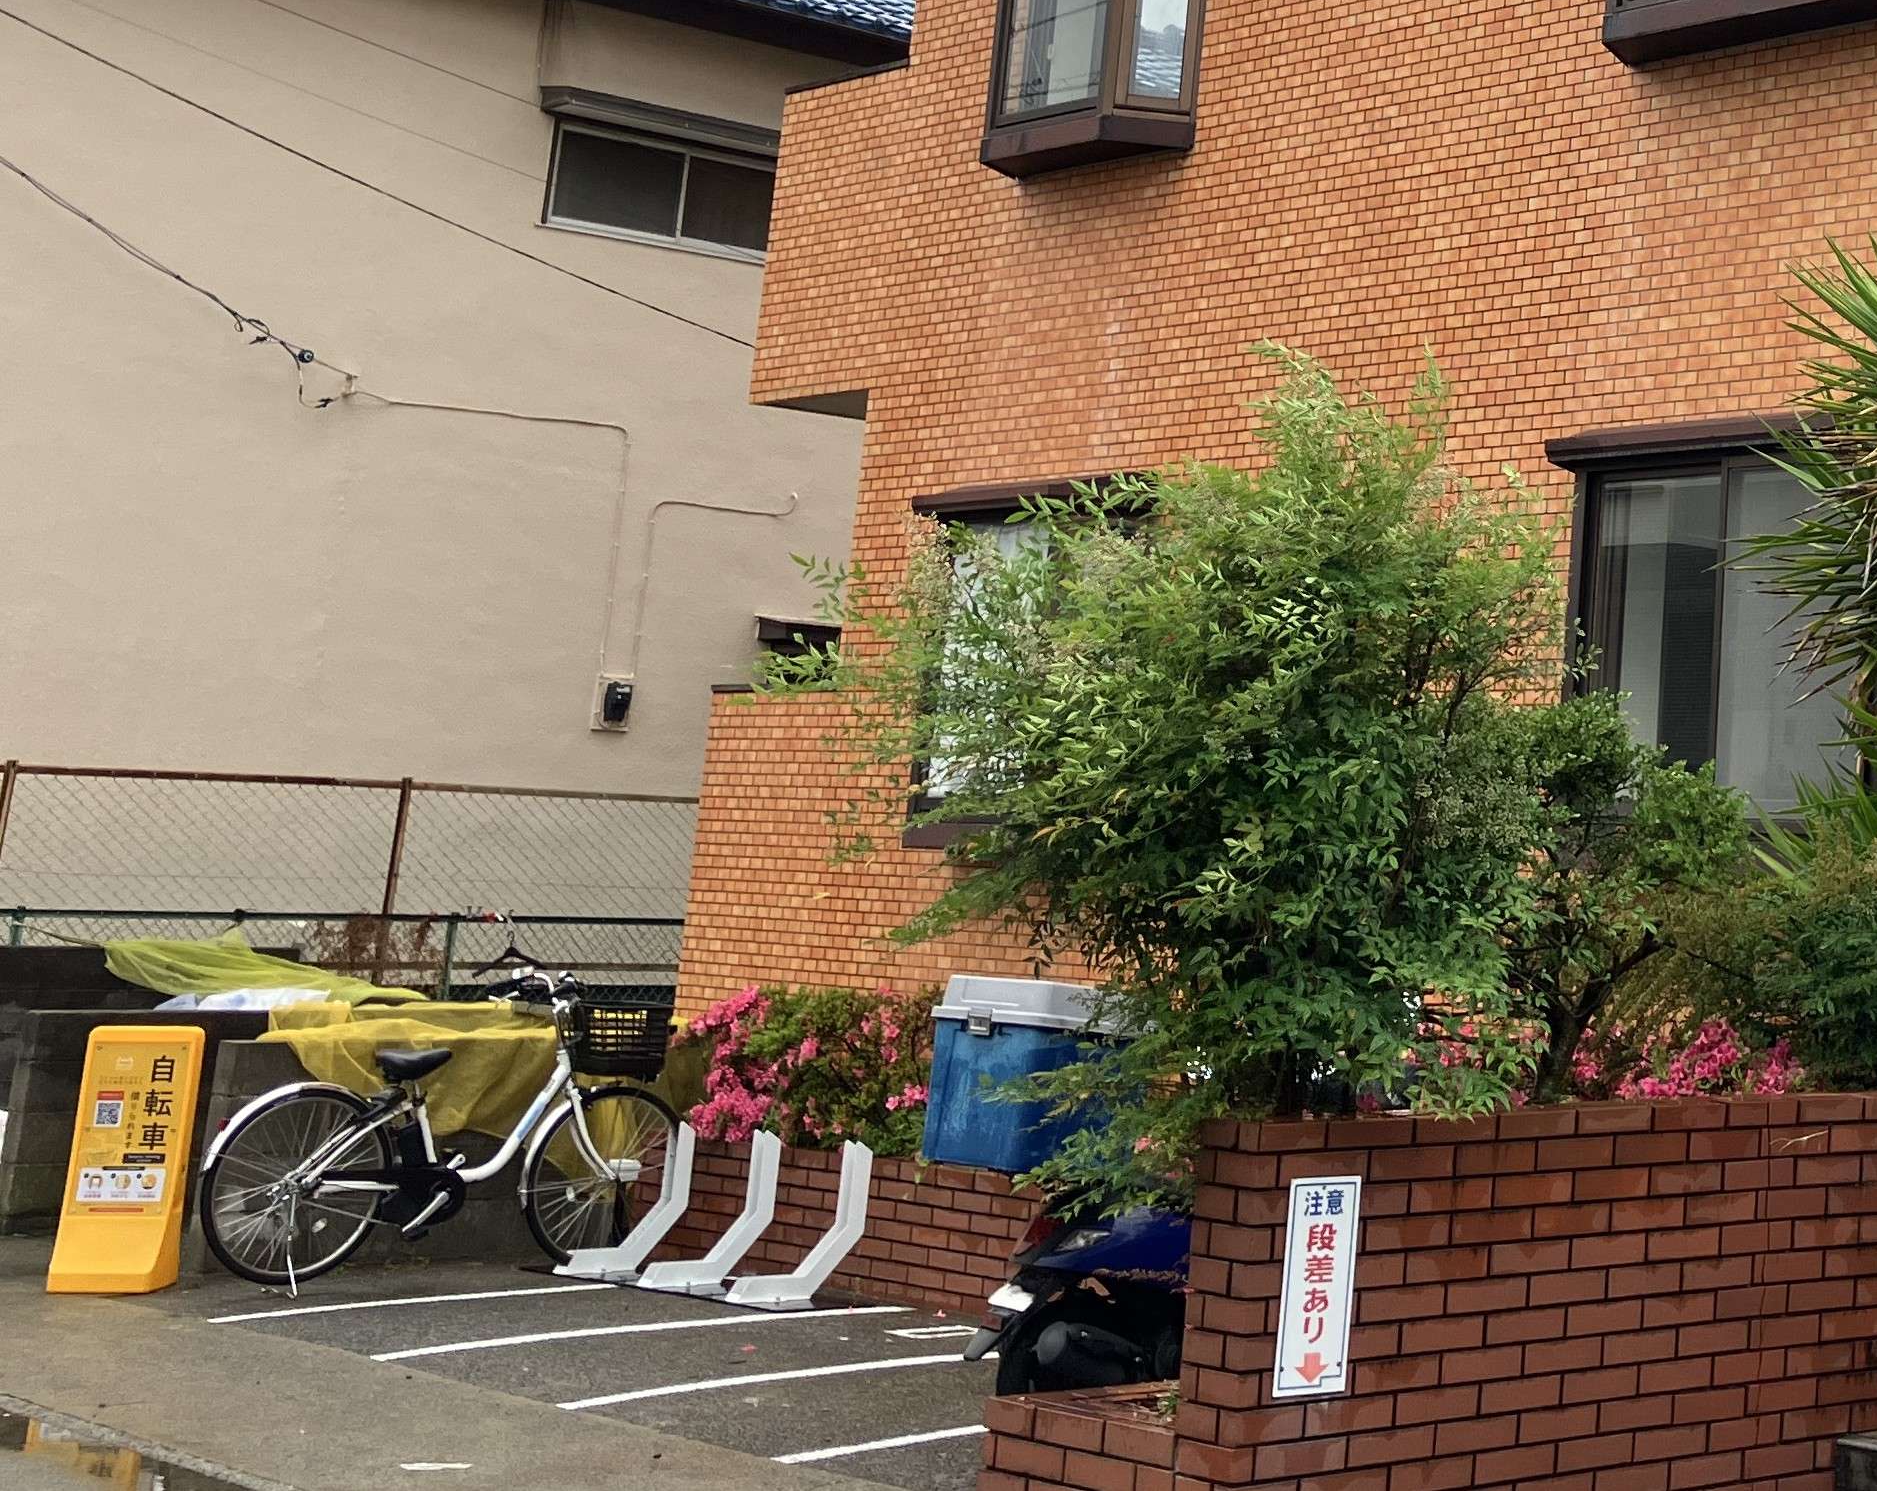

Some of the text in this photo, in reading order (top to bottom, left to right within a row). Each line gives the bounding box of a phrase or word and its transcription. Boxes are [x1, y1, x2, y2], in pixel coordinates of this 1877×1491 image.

[138, 1055, 175, 1151] 自転車
[1303, 1189, 1345, 1216] 注意
[1302, 1223, 1337, 1343] 段差あり
